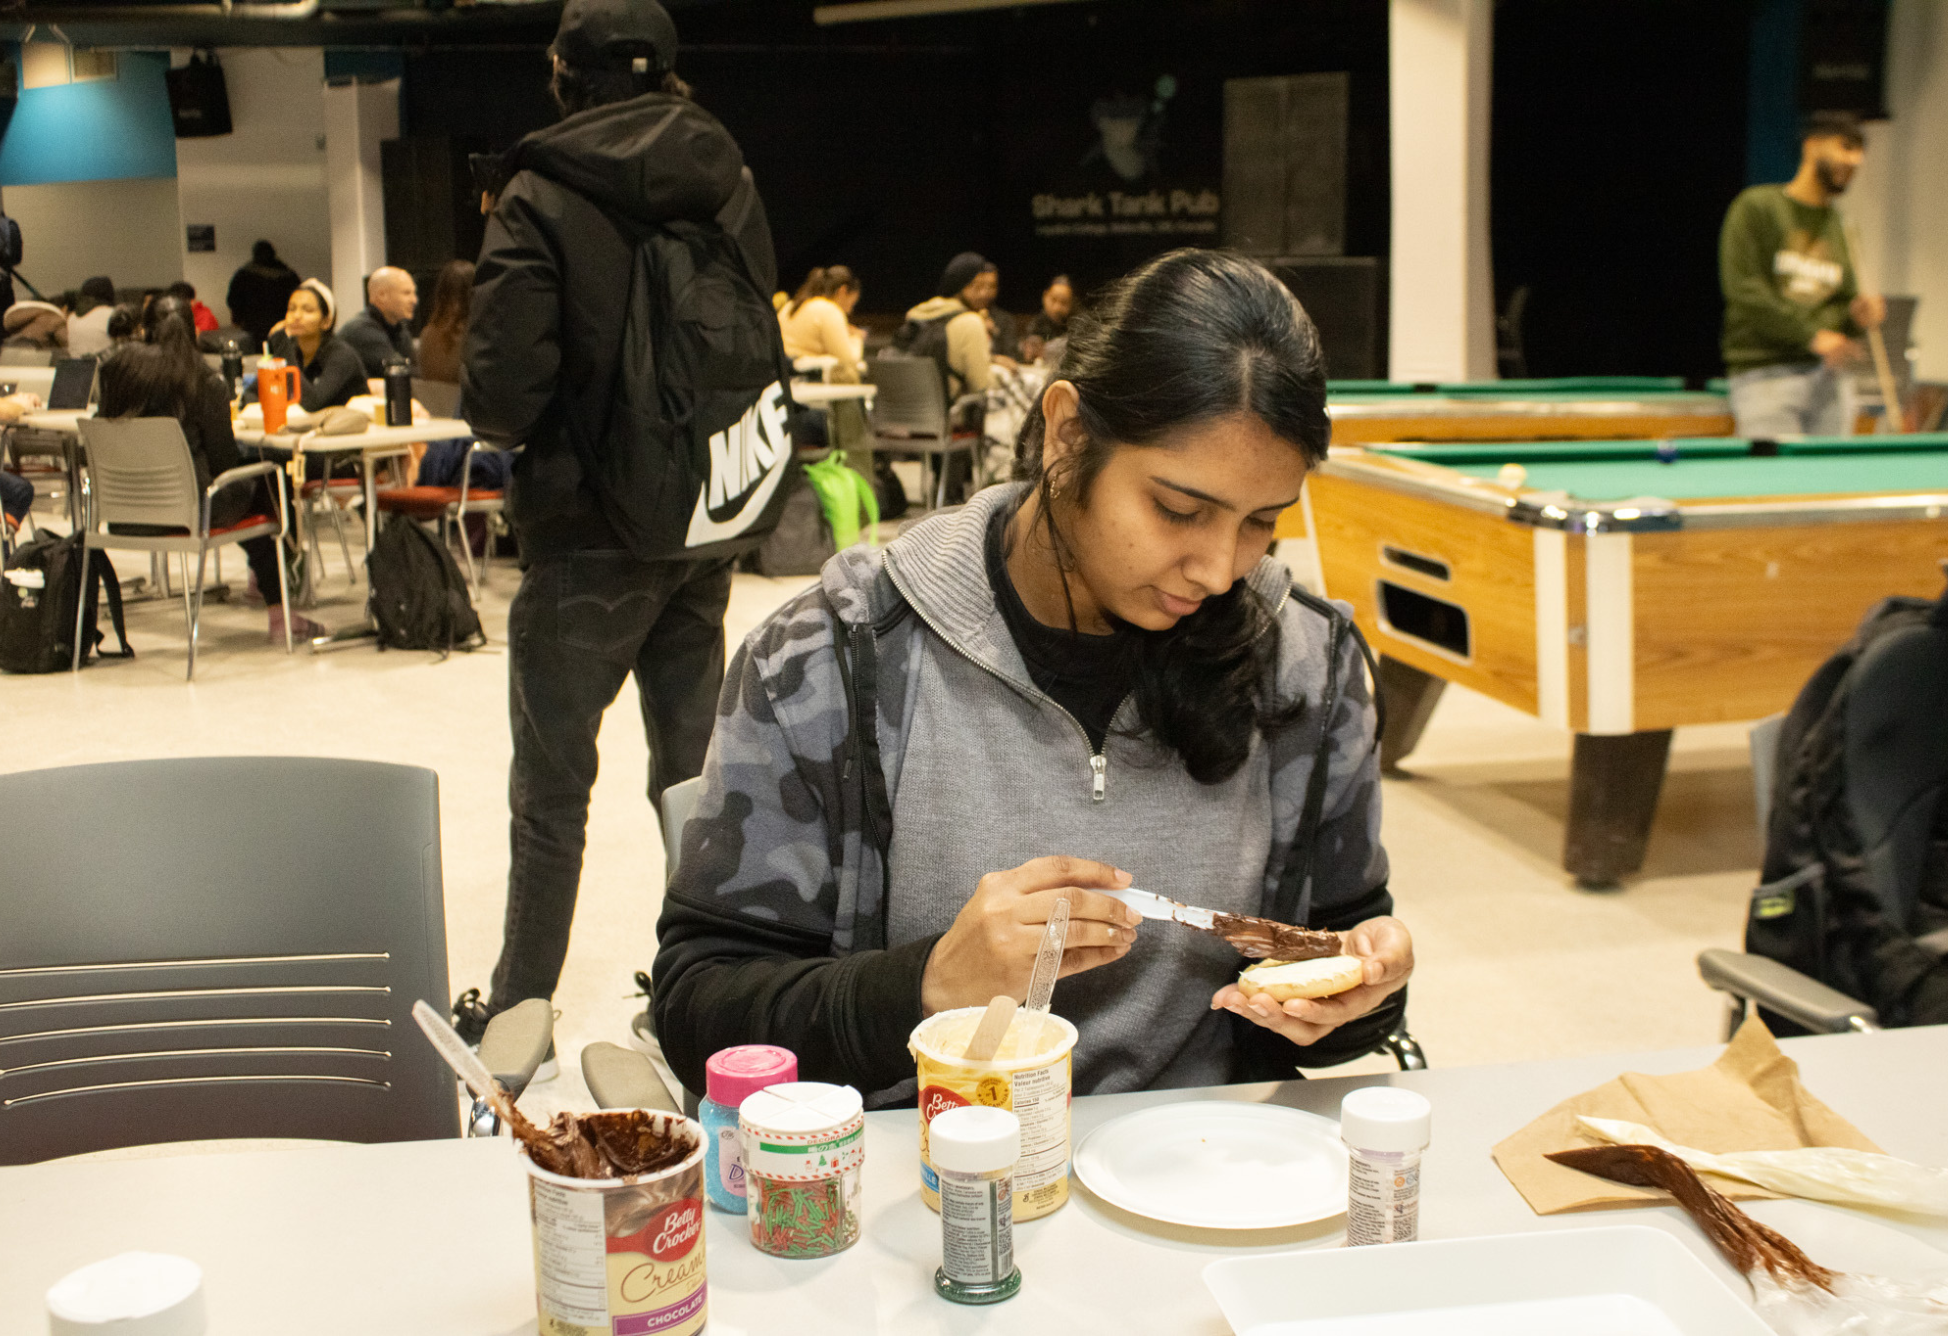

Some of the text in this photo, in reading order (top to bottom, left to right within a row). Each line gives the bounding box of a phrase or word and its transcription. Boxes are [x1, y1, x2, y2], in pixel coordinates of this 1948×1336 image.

[1032, 189, 1220, 218] Shark Tank Pub
[708, 380, 788, 511] NIKE
[653, 1217, 702, 1255] Crocker
[664, 1207, 696, 1234] Betty
[647, 1292, 703, 1327] CHOCOLATE
